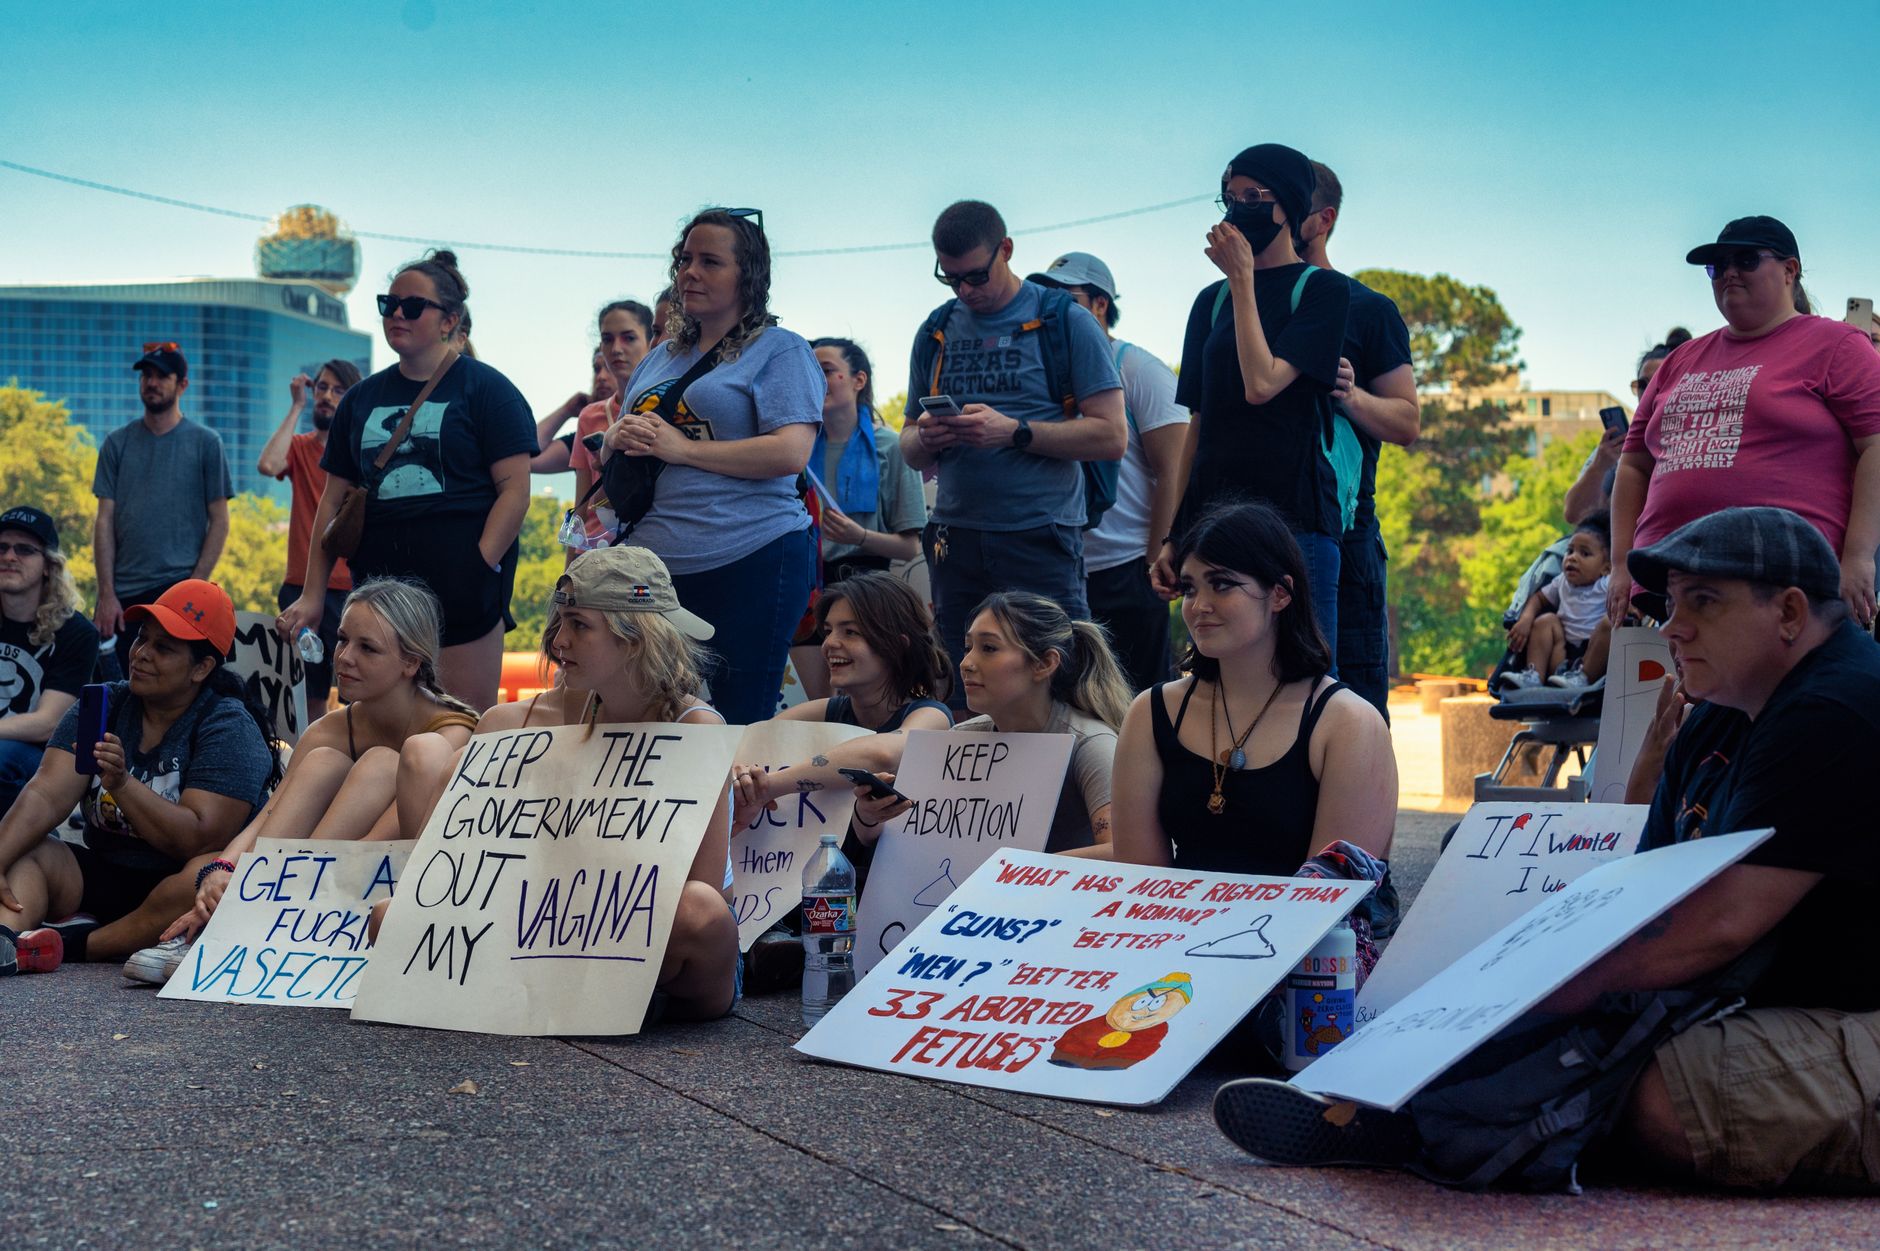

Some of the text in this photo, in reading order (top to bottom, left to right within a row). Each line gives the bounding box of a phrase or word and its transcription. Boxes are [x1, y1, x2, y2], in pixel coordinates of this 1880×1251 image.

[1680, 365, 1763, 384] PRO-CHOICE
[1663, 396, 1747, 414] WOMEN THE
[1681, 393, 1710, 402] GIVING
[1711, 384, 1750, 401] OTHER
[1660, 424, 1743, 445] CHOICES
[1661, 409, 1744, 432] RIGHT TO MAKE
[1711, 439, 1738, 450] NOT
[1682, 461, 1734, 470] MYSELF
[449, 730, 683, 792] KEEP THE
[942, 742, 1009, 782] KEEP
[442, 793, 698, 843] GOVERNMENT
[902, 793, 1024, 842] ABORTION
[1519, 813, 1563, 857] I
[739, 846, 794, 874] them
[240, 855, 398, 901] GET A
[415, 849, 527, 911] OUT
[1071, 874, 1125, 893] HAS
[1127, 877, 1204, 900] MORE
[1200, 882, 1290, 902] RIGHTS
[1287, 886, 1350, 904] THAN
[1506, 866, 1538, 895] I
[809, 910, 838, 920] Ozarka
[1091, 900, 1123, 919] A
[403, 863, 659, 986] MY VAGINA
[1073, 926, 1186, 950] "BETTER"
[1304, 957, 1337, 973] BOSS
[868, 988, 1095, 1025] 33 ABORTED
